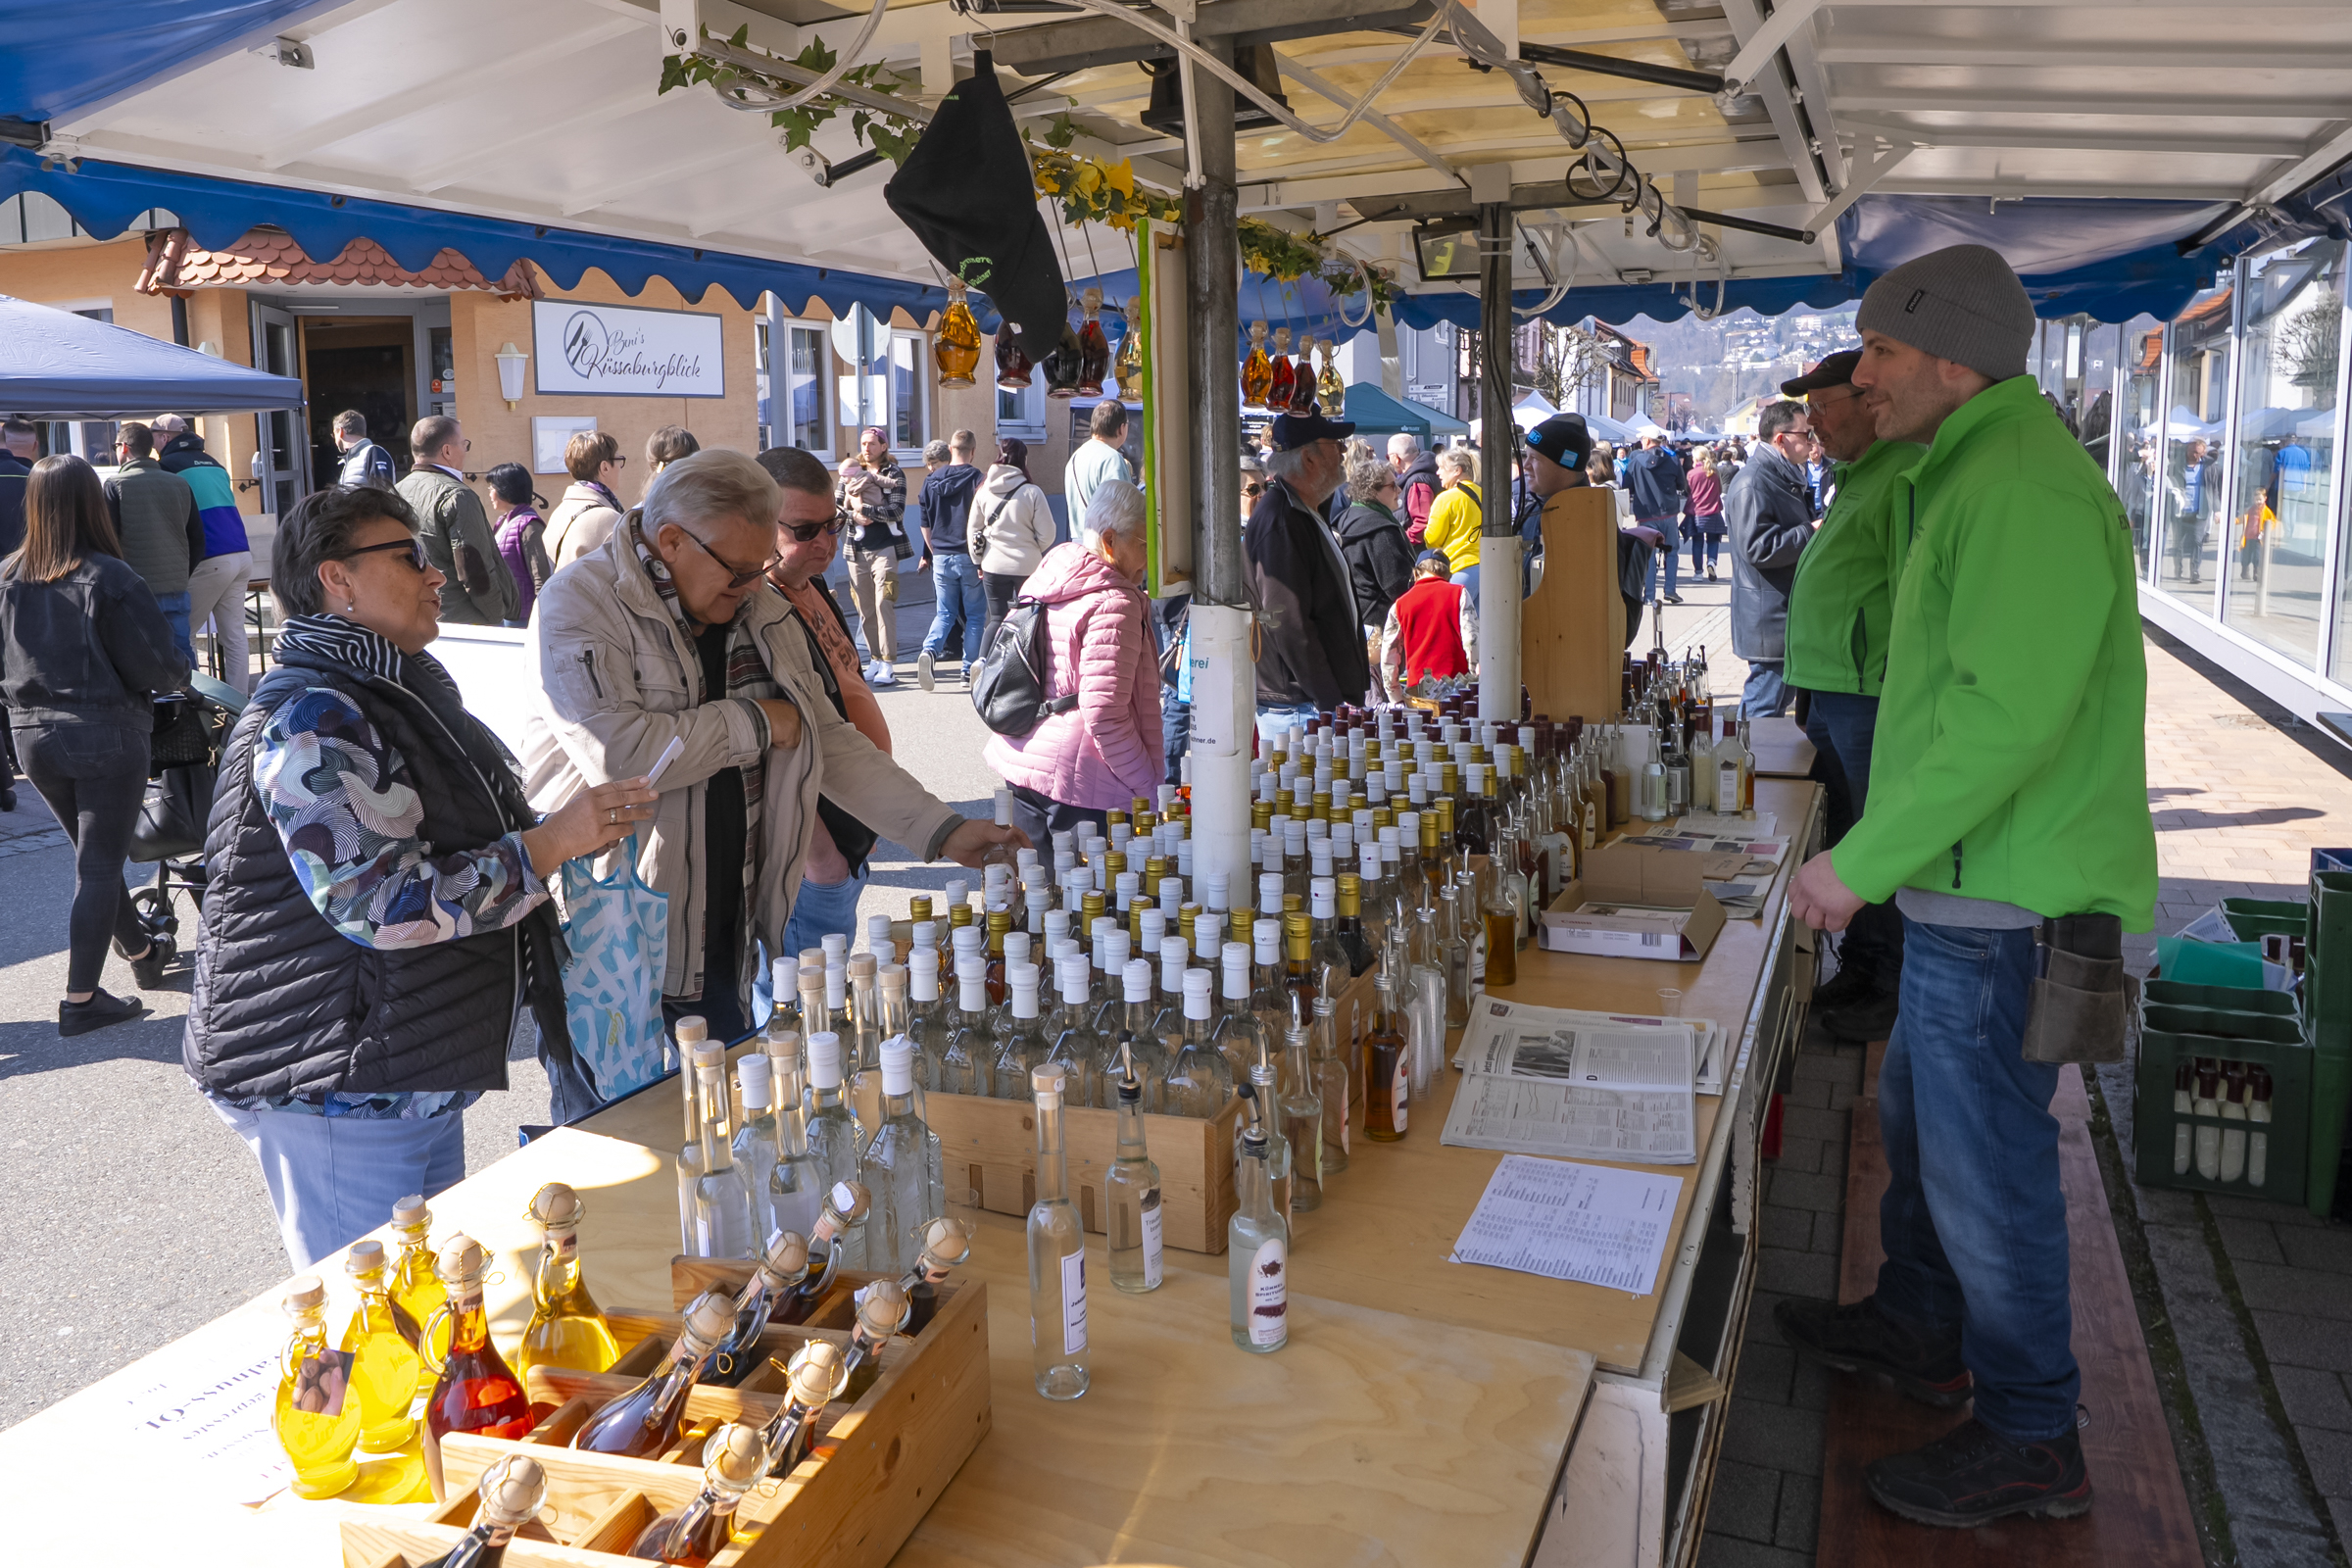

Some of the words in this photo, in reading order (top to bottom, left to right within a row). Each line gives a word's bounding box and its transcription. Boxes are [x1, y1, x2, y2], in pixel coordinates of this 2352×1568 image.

[608, 327, 645, 355] Beni's
[581, 343, 701, 389] Küssaburgblick
[183, 1393, 266, 1440] gepresstes
